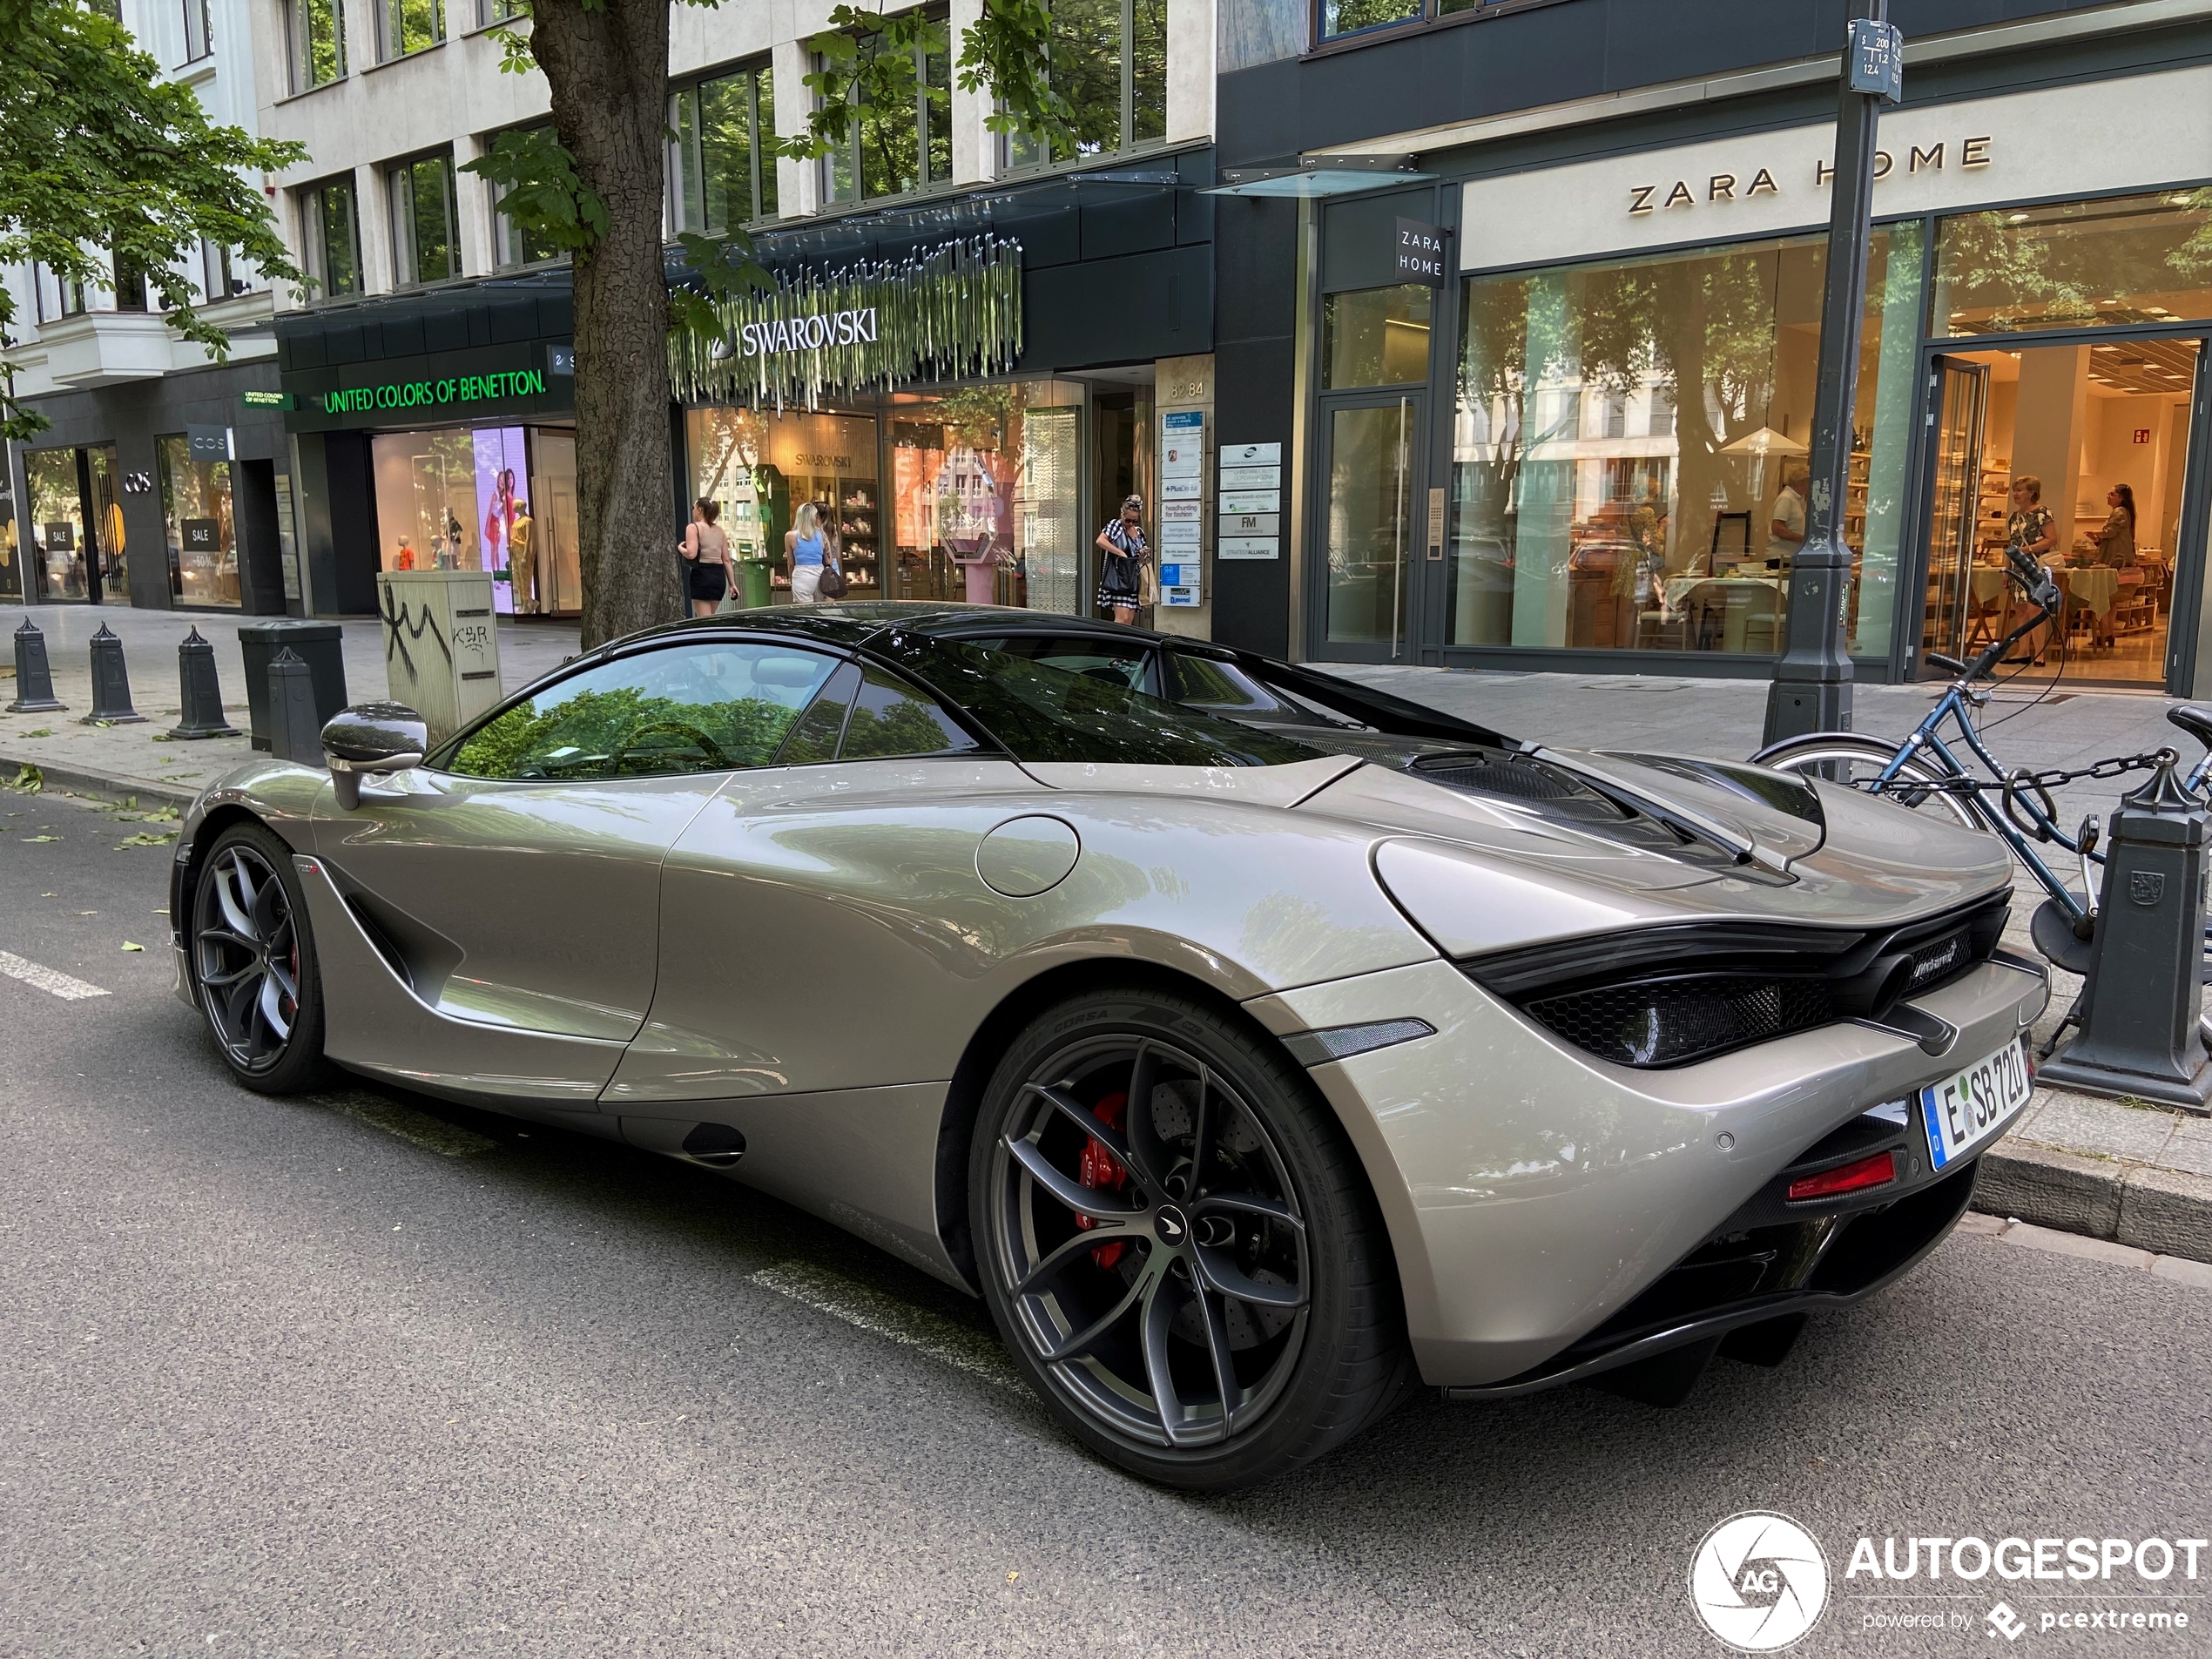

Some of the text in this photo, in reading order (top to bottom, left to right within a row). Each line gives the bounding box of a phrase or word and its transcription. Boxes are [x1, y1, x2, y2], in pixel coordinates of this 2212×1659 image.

[1876, 37, 1890, 49] 200
[1628, 167, 1779, 214] ZARA
[1401, 231, 1441, 253] ZARA
[1399, 254, 1442, 276] HOME
[742, 307, 878, 357] SWAROVSKI
[324, 388, 374, 414] UNITED
[376, 381, 434, 408] COLORS
[436, 379, 456, 403] OF
[1170, 382, 1204, 398] 82 84
[193, 436, 226, 450] COS
[795, 454, 851, 469] SWAROVSKI
[125, 471, 152, 493] COS
[52, 530, 66, 543] SALE
[192, 529, 209, 542] SALE
[1053, 1009, 1109, 1035] CORSA
[1944, 1043, 2024, 1146] E SB 720
[1932, 1134, 1939, 1151] D
